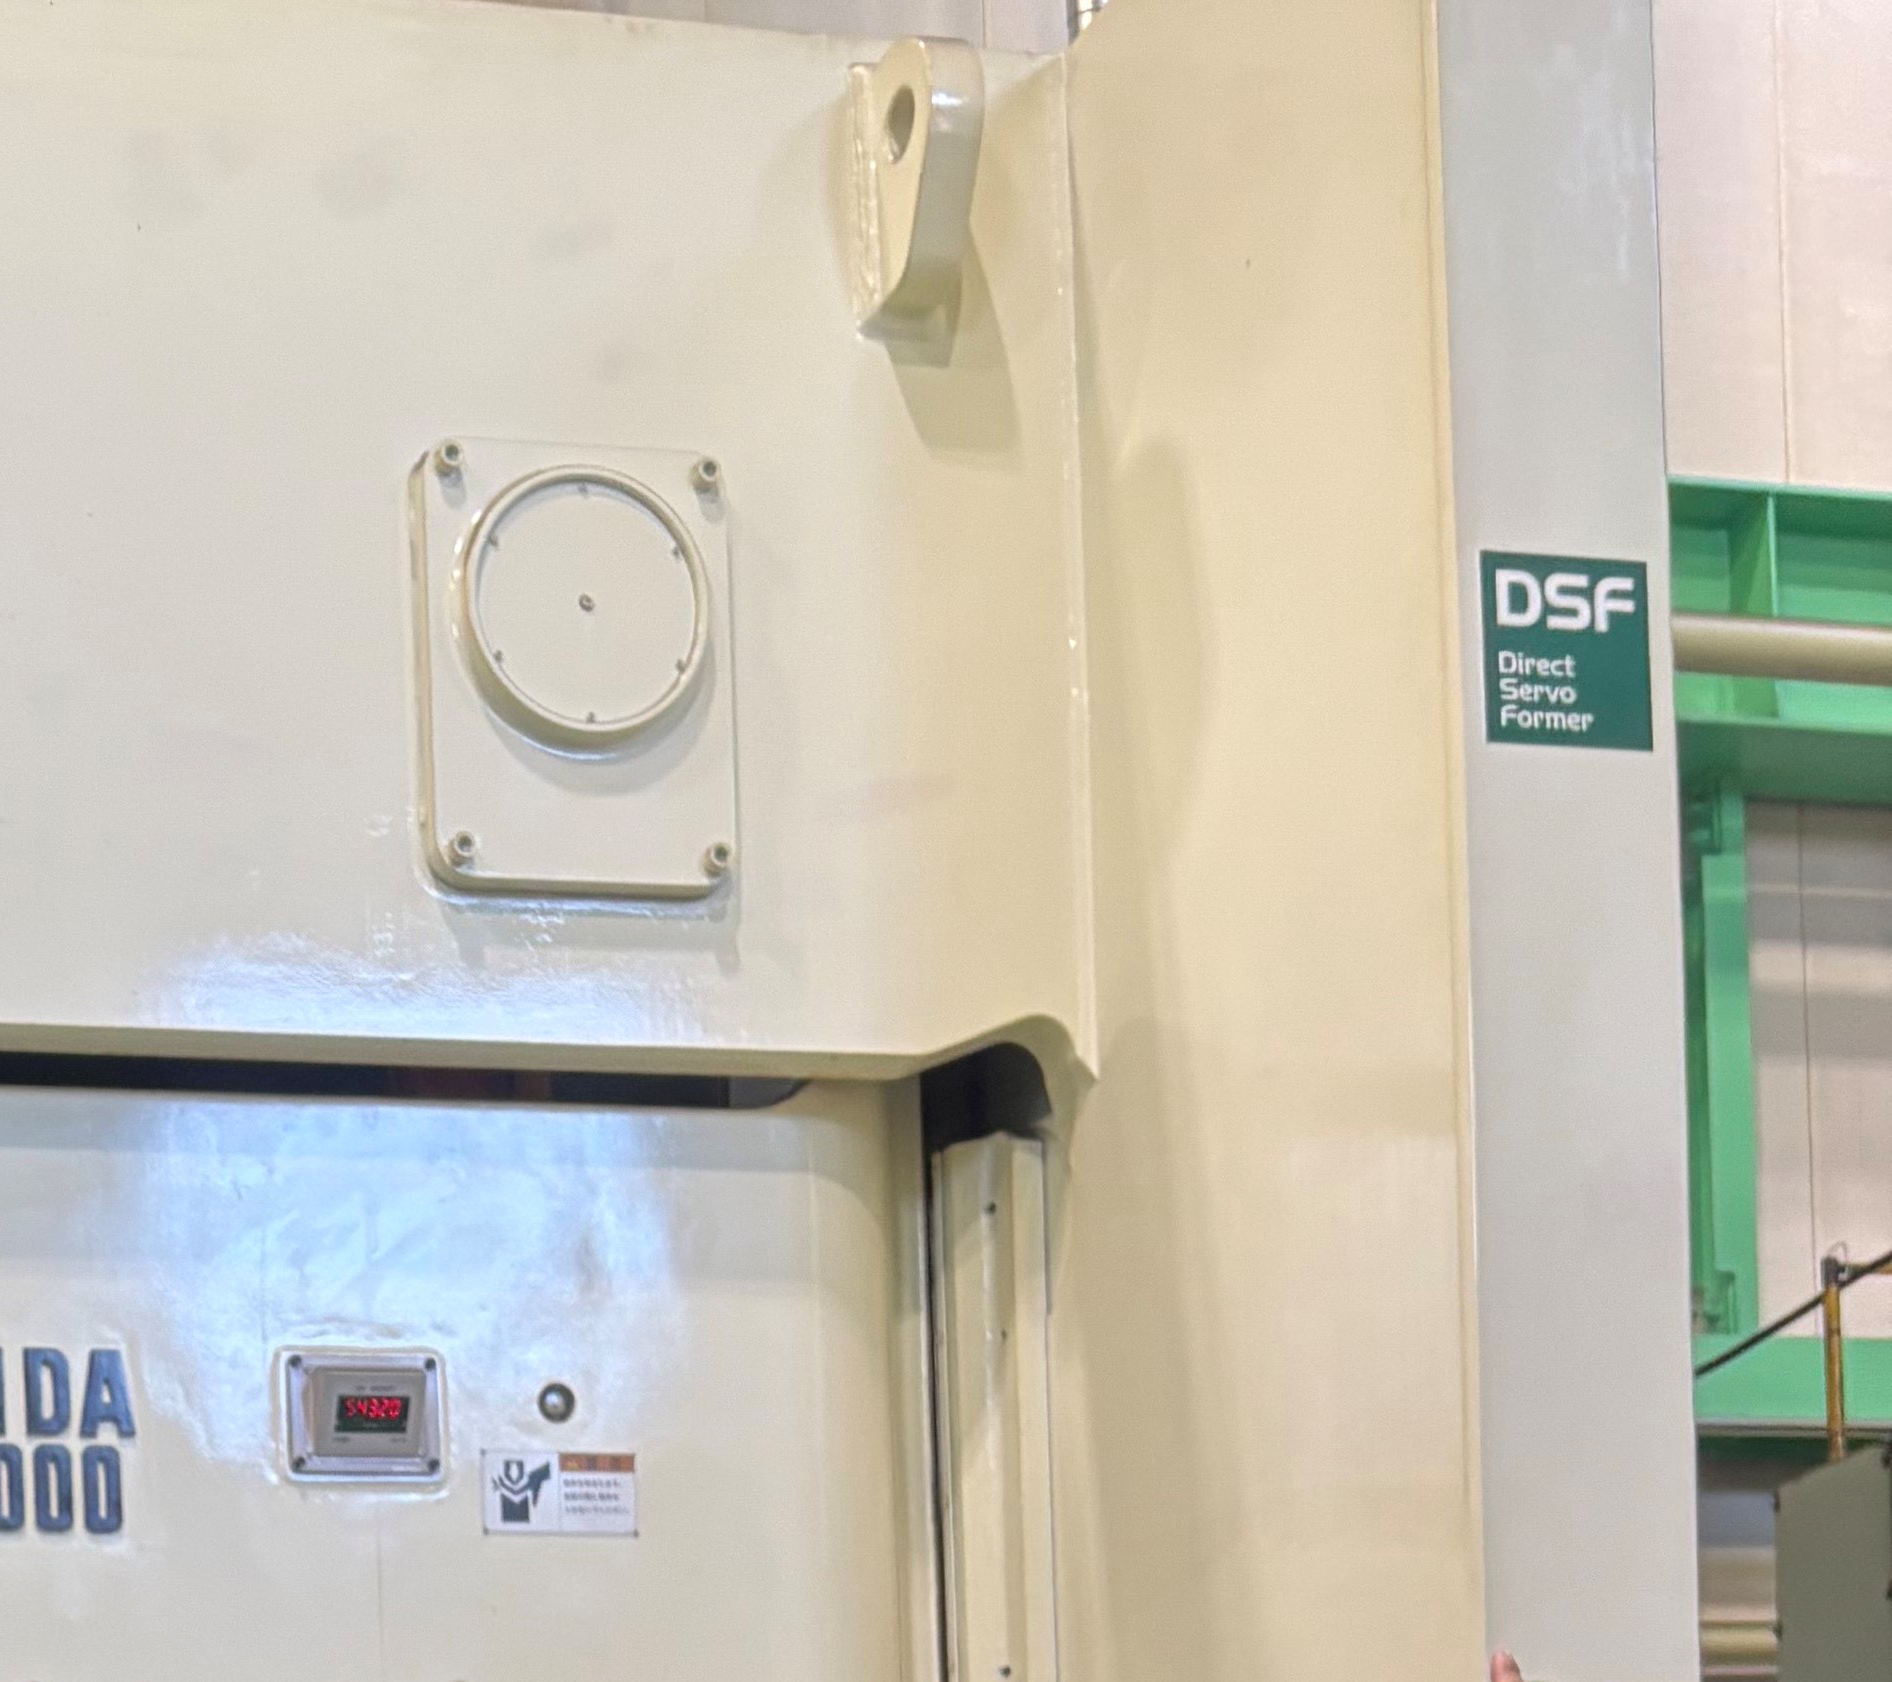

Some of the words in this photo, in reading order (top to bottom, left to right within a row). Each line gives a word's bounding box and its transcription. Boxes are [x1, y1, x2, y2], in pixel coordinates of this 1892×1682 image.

[1495, 568, 1636, 633] DSF
[1498, 651, 1576, 678] Direct
[1499, 678, 1577, 704] Servo
[1500, 704, 1594, 732] Former
